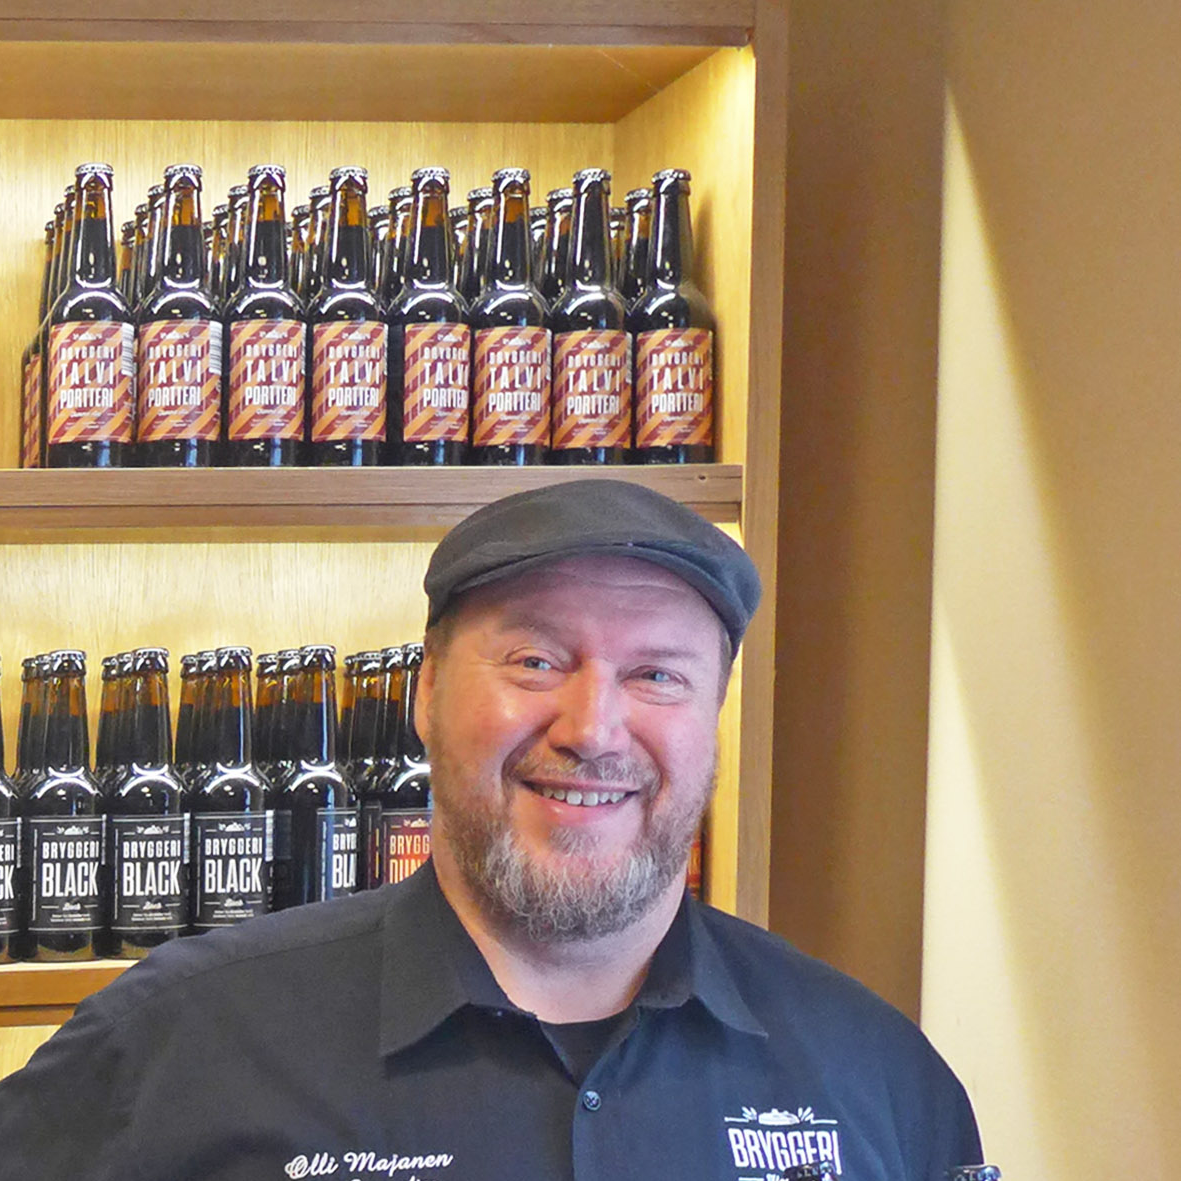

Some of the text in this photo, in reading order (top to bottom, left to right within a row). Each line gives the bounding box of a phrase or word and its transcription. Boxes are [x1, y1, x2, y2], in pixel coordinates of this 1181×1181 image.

[61, 362, 114, 385] TALVI
[149, 361, 201, 384] TALVI
[246, 360, 297, 383] TALVI
[329, 361, 380, 384] TALVI
[424, 362, 468, 384] TALVI
[489, 366, 541, 389] TALVI
[569, 370, 619, 392] TALVI
[652, 368, 703, 390] TALVI
[60, 387, 113, 409] PORTTERI
[148, 386, 201, 407] PORTTERI
[245, 386, 296, 406] PORTTERI
[328, 387, 379, 407] PORTTERI
[423, 388, 467, 408] PORTTERI
[488, 392, 541, 412] PORTTERI
[567, 395, 619, 415] PORTTERI
[651, 393, 703, 413] PORTTERI
[42, 841, 99, 859] BRYGGERI
[123, 840, 180, 858] BRYGGERI
[205, 837, 262, 855] BRYGGERI
[42, 861, 98, 897] BLACK
[122, 860, 180, 896] BLACK
[205, 858, 262, 893] BLACK
[728, 1128, 842, 1175] BRYGGERI
[285, 1151, 453, 1180] Olli Majanen
